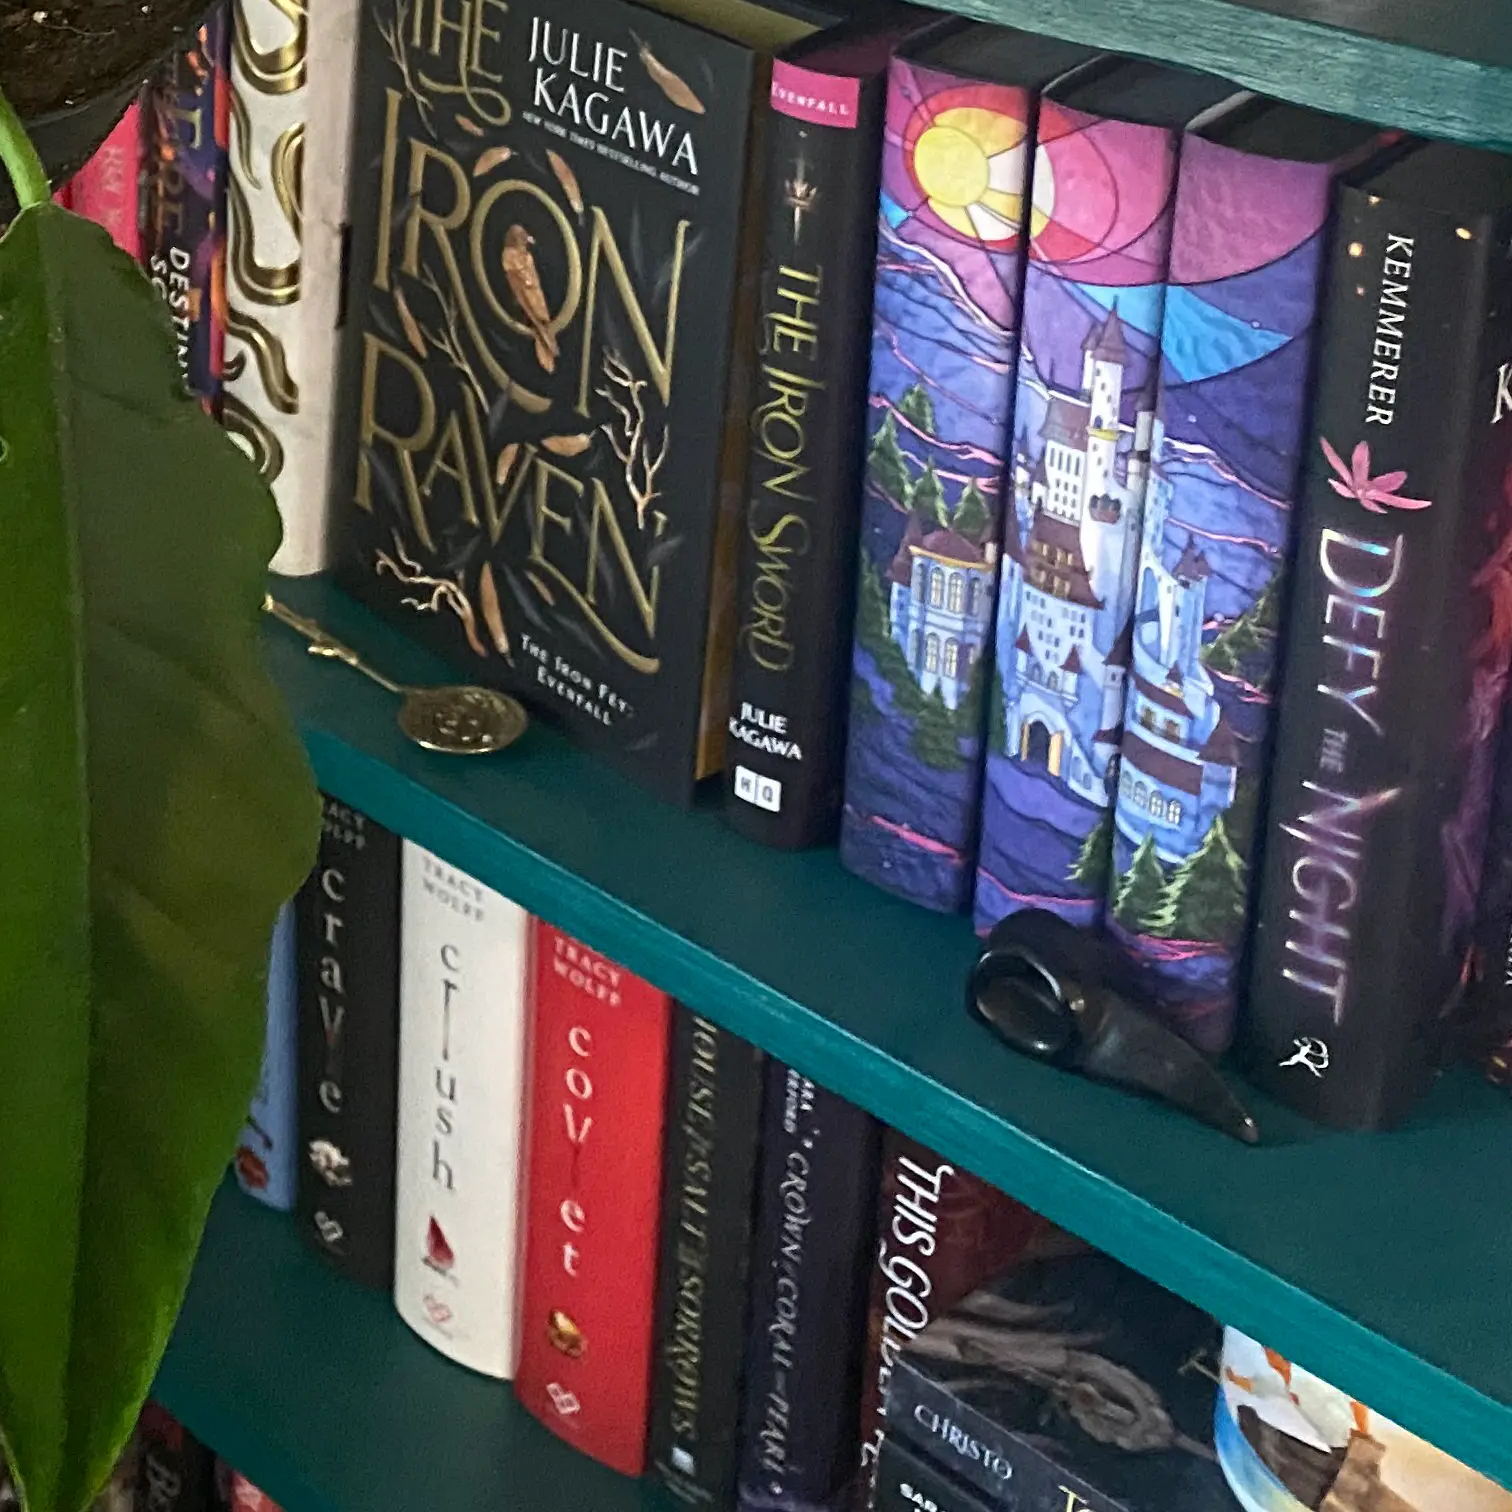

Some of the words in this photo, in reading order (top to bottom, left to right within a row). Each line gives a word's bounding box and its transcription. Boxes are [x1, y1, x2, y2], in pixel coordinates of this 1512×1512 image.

[528, 16, 629, 93] JULIE
[532, 67, 699, 176] KAGAWA
[770, 81, 850, 117] EVENFALL
[374, 86, 692, 419] IRON
[760, 263, 824, 363] THE
[1364, 231, 1416, 427] KEMMERER
[750, 363, 827, 503] IRON
[353, 330, 669, 675] RAVEN
[738, 499, 811, 673] SWORD
[520, 632, 549, 665] THE
[554, 655, 593, 691] IRON
[1317, 526, 1404, 737] DEFY
[536, 664, 613, 727] EVENFALL
[740, 700, 789, 735] JULIE
[728, 716, 803, 762] KAGAWA
[1318, 726, 1349, 774] THE
[324, 800, 367, 832] ACY
[421, 854, 485, 903] TRACY
[421, 877, 486, 924] WOLFF
[1278, 778, 1403, 1026] NIGHT
[552, 956, 623, 1010] WOLFF
[553, 934, 622, 989] TRACY
[778, 1150, 812, 1264] CROWN
[891, 1155, 954, 1257] THIS
[913, 1403, 1014, 1481] CHRISTO
